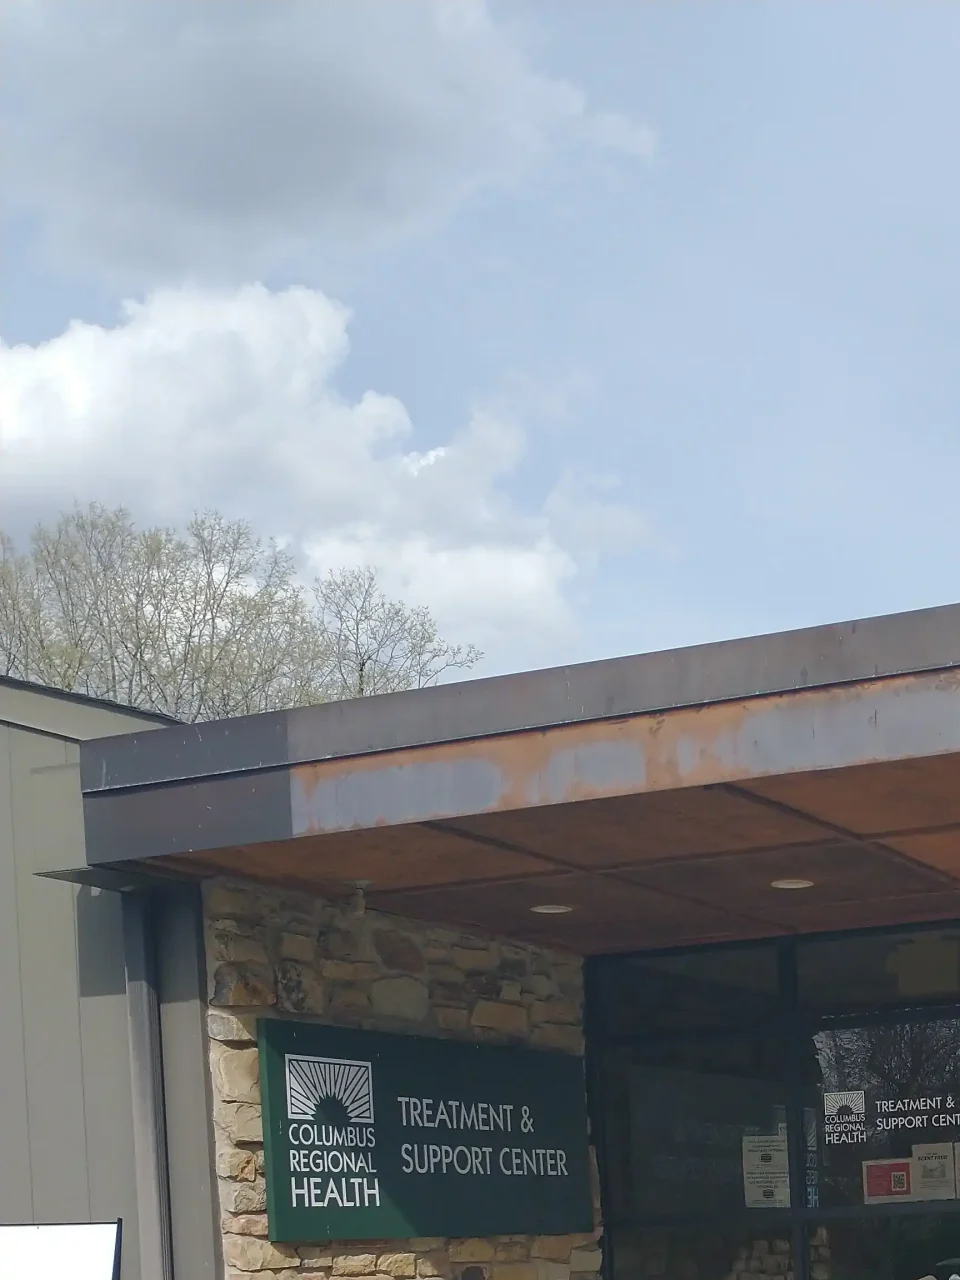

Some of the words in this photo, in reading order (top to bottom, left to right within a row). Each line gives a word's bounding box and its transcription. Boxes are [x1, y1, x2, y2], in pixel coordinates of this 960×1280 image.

[875, 1097, 942, 1112] TREATMENT
[946, 1095, 955, 1108] &
[397, 1097, 514, 1132] TREATMENT
[520, 1105, 535, 1133] &
[825, 1113, 866, 1123] COLUMBUS
[876, 1115, 929, 1130] SUPPORT
[288, 1123, 376, 1147] COLUMBUS
[825, 1122, 866, 1132] REGIONAL
[825, 1131, 867, 1144] HEALTH
[289, 1149, 377, 1173] REGIONAL
[401, 1144, 493, 1175] SUPPORT
[499, 1147, 569, 1176] CENTER
[290, 1176, 381, 1207] HEALTH
